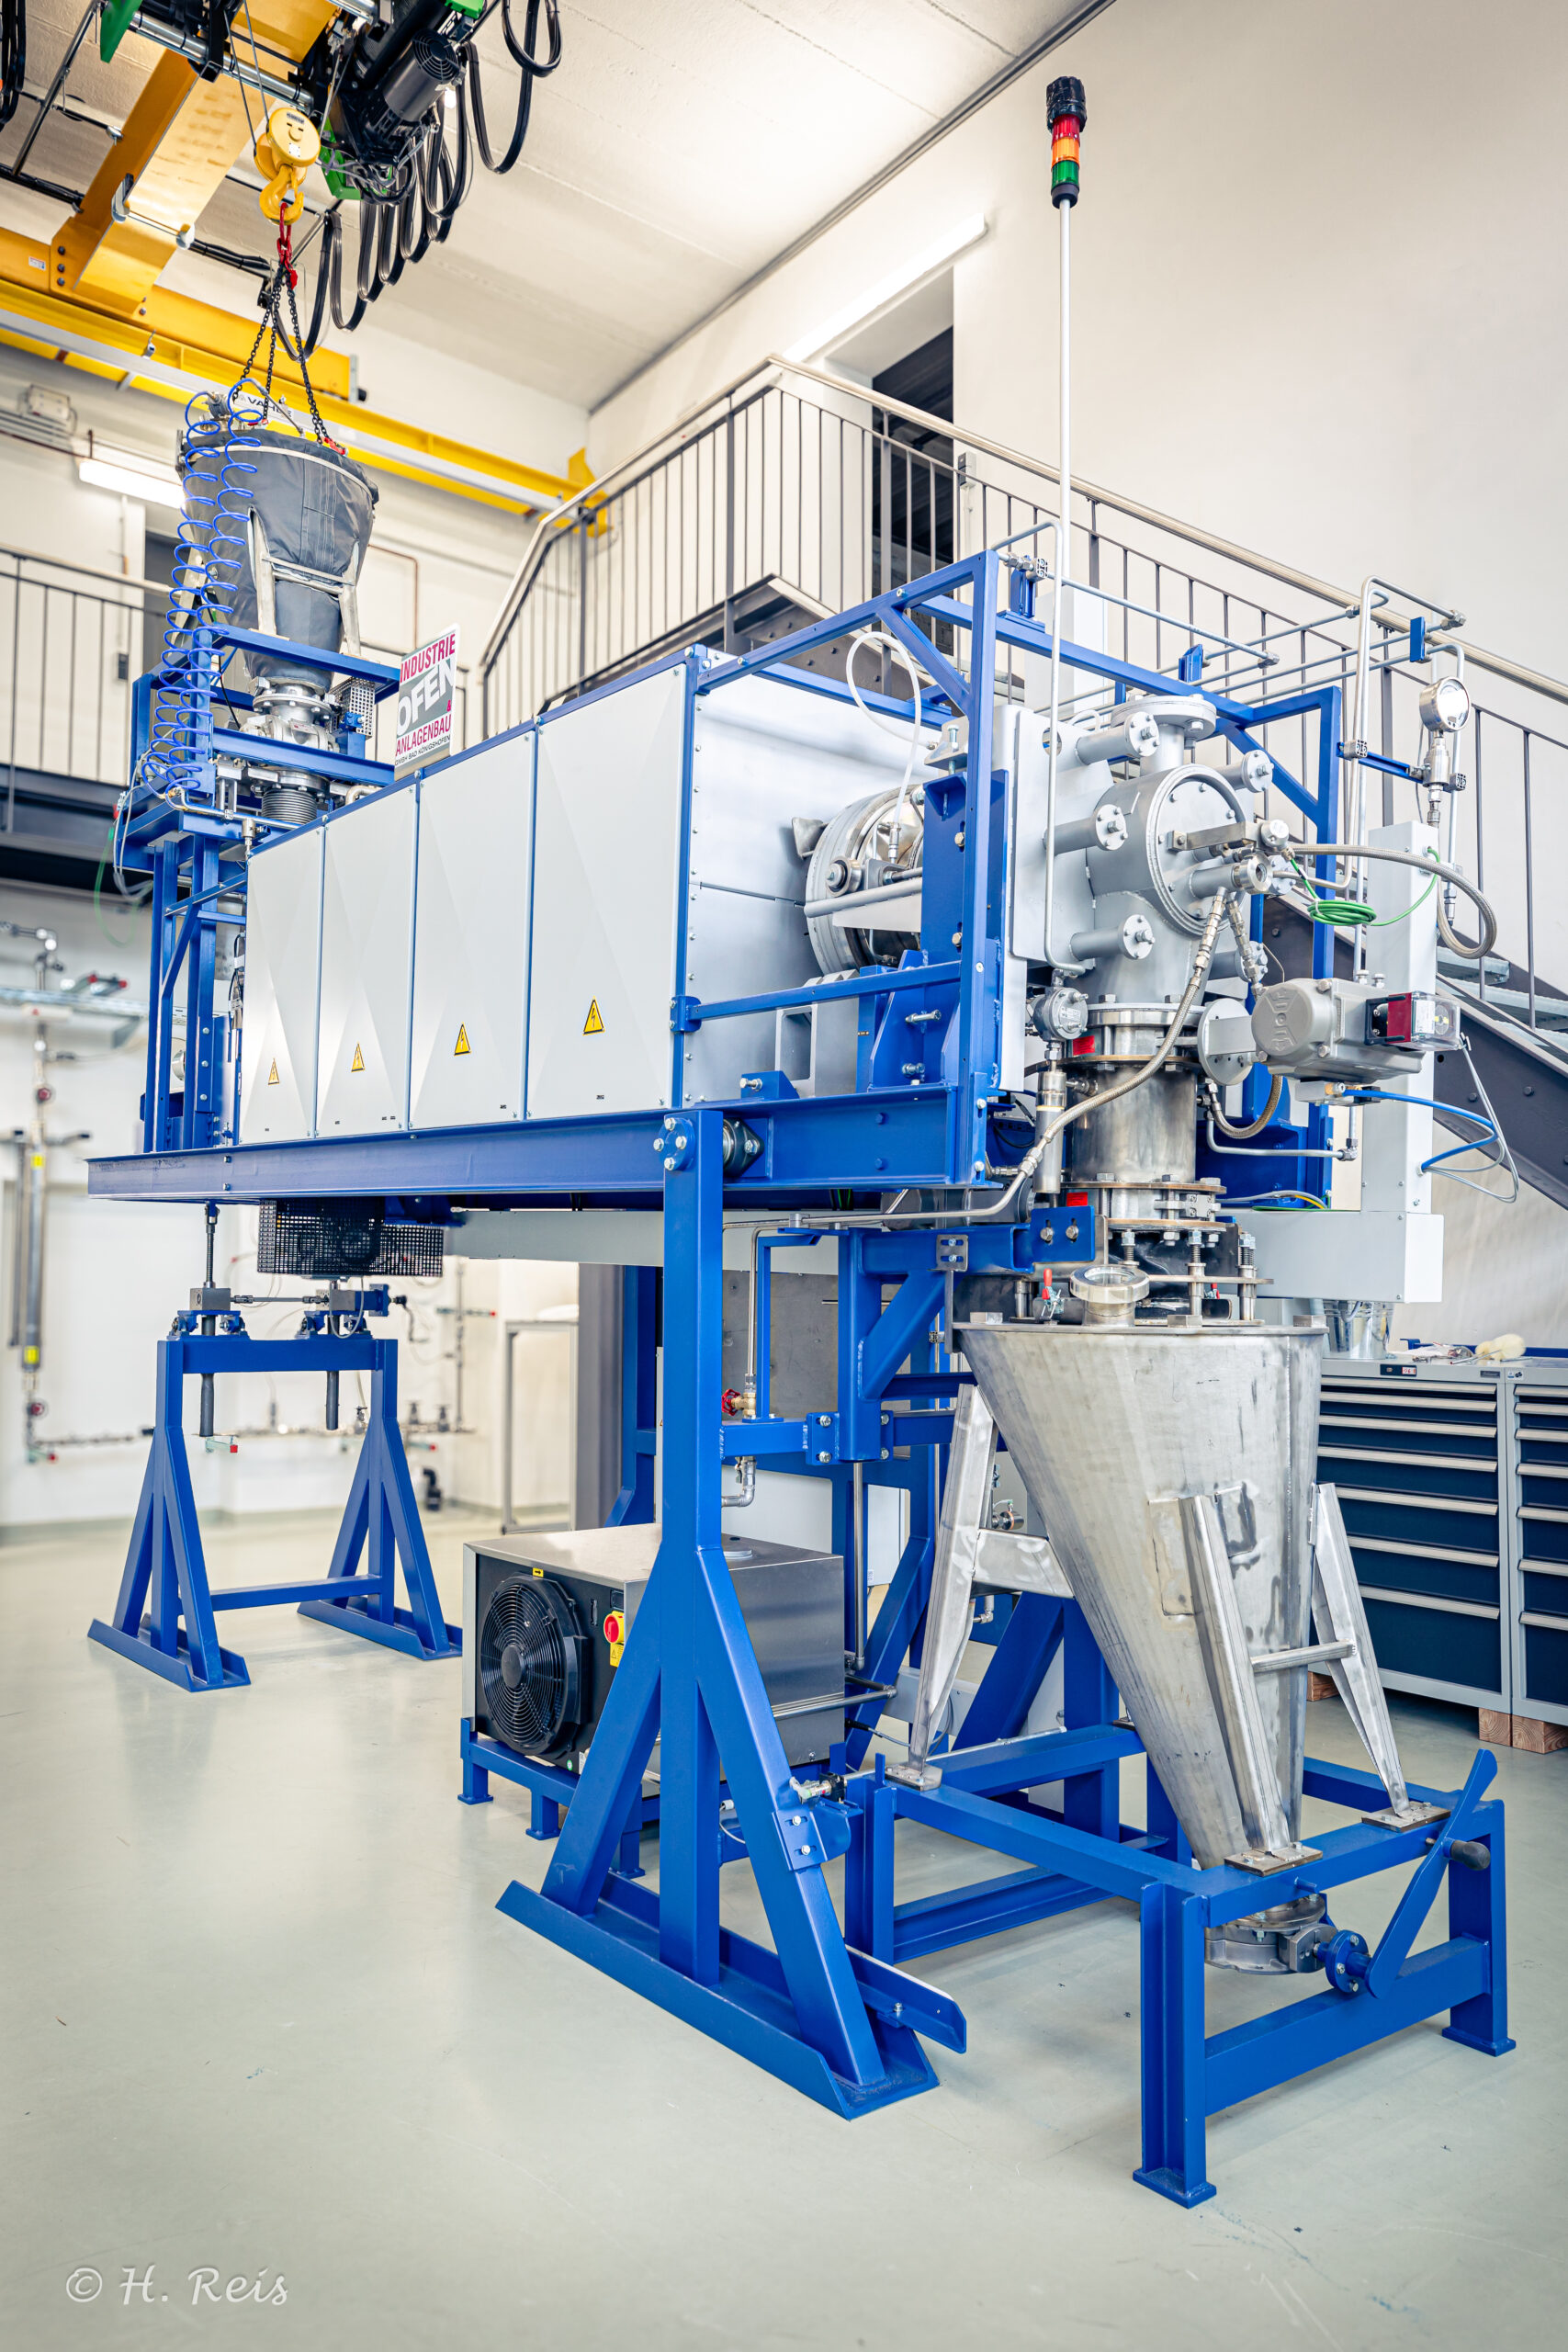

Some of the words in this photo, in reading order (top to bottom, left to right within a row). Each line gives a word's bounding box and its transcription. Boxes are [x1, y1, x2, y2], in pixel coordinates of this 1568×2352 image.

[400, 633, 456, 684] INDUSTRIE
[397, 657, 456, 736] OFEN
[446, 699, 451, 712] &
[395, 713, 451, 757] ANLAGENBAU
[408, 751, 417, 760] BAD
